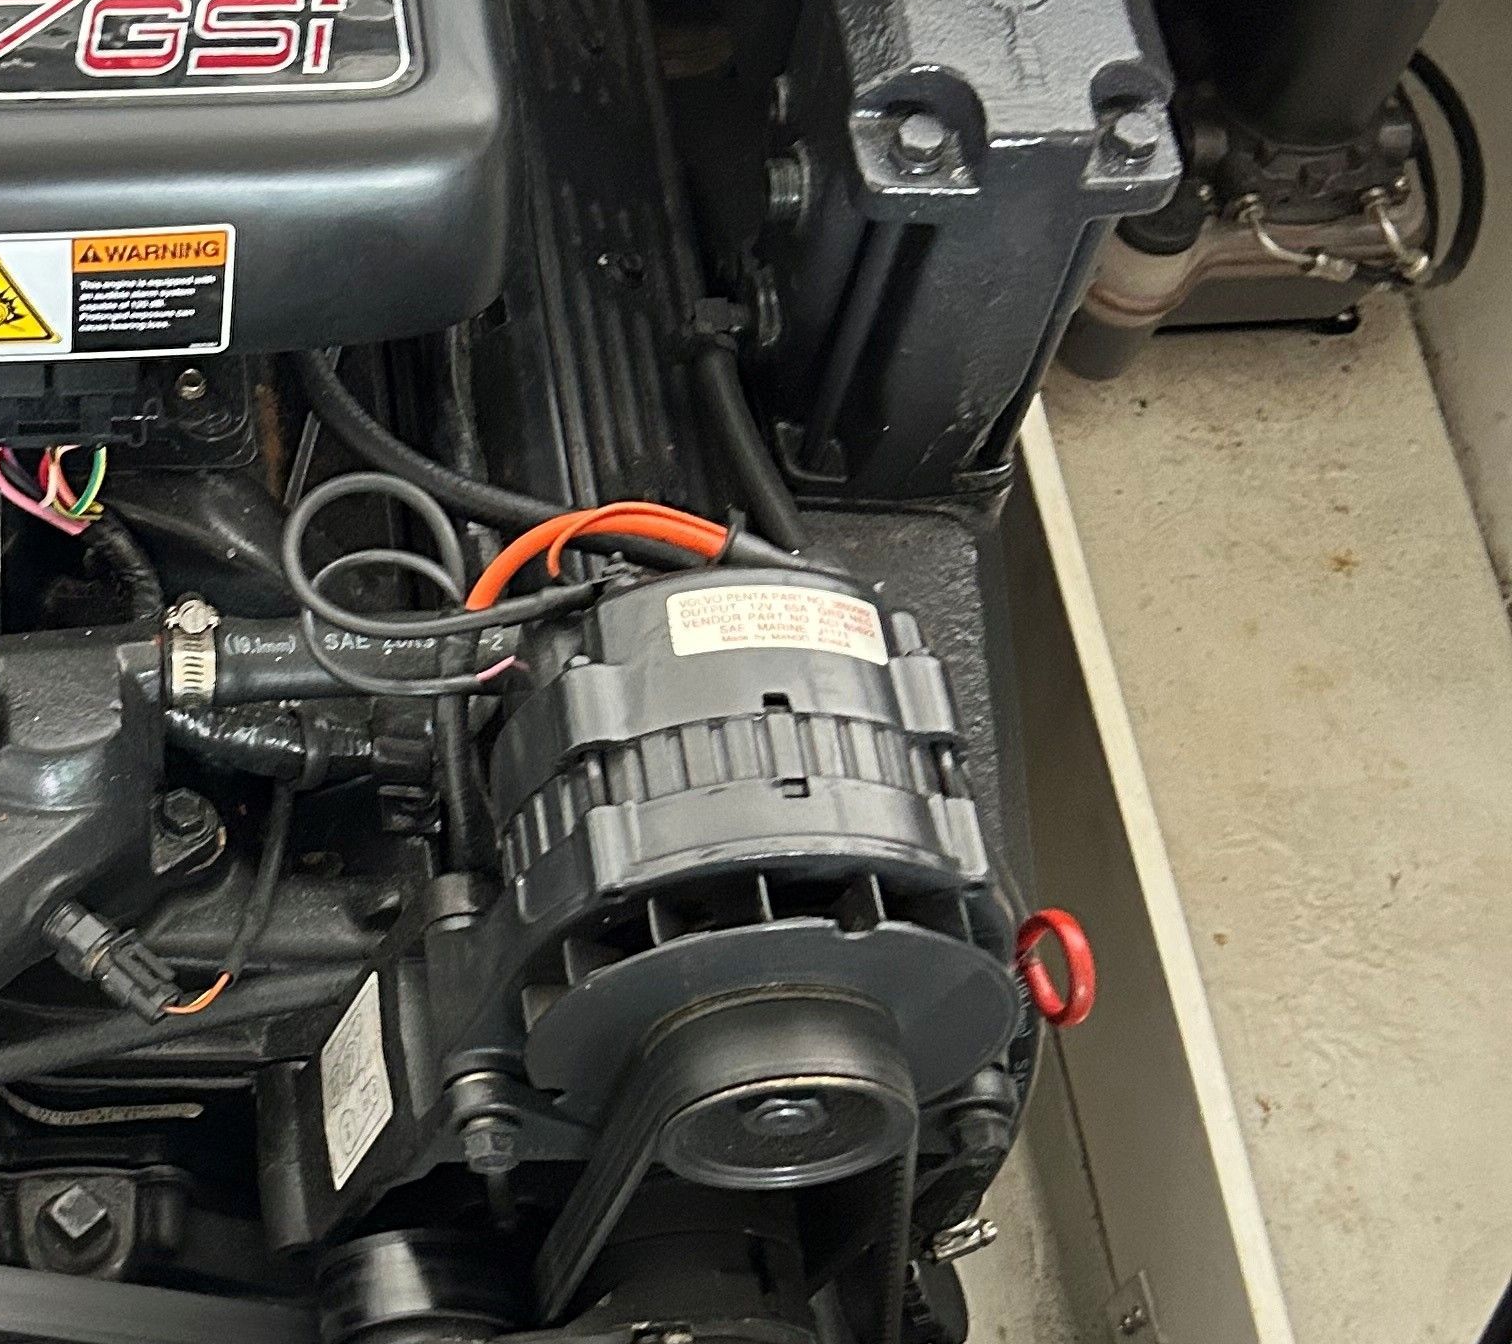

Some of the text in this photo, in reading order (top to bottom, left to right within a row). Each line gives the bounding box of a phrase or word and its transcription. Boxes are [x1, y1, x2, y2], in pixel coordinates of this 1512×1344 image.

[104, 239, 220, 263] WARNING
[679, 594, 722, 608] VOLVO
[727, 592, 768, 601] PENTA
[772, 592, 802, 602] PART
[680, 603, 735, 618] OUTPUT
[750, 603, 772, 612] 12V
[681, 613, 741, 629] VENDOR
[748, 612, 783, 621] PART
[720, 624, 744, 634] SAE
[757, 623, 807, 633] MARINE
[324, 632, 371, 651] SAE
